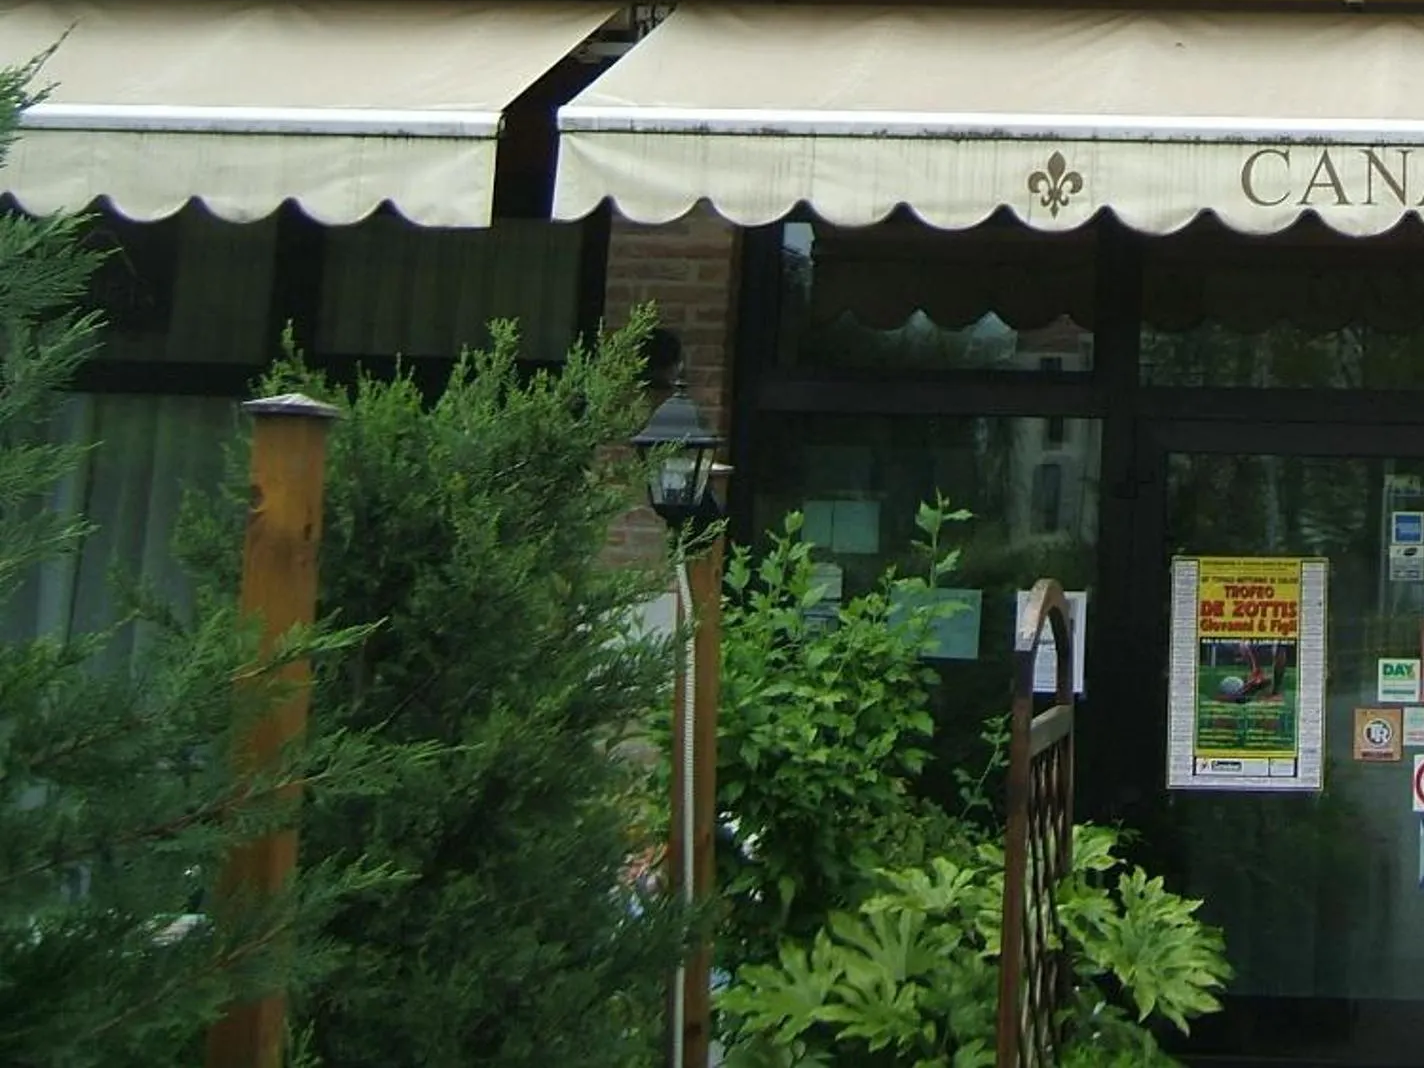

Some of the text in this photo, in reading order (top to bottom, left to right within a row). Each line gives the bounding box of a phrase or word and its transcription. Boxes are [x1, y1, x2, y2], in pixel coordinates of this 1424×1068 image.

[1200, 601, 1297, 618] DE ZOTTIS
[1200, 619, 1254, 632] Giovanni
[1383, 663, 1413, 676] DAY
